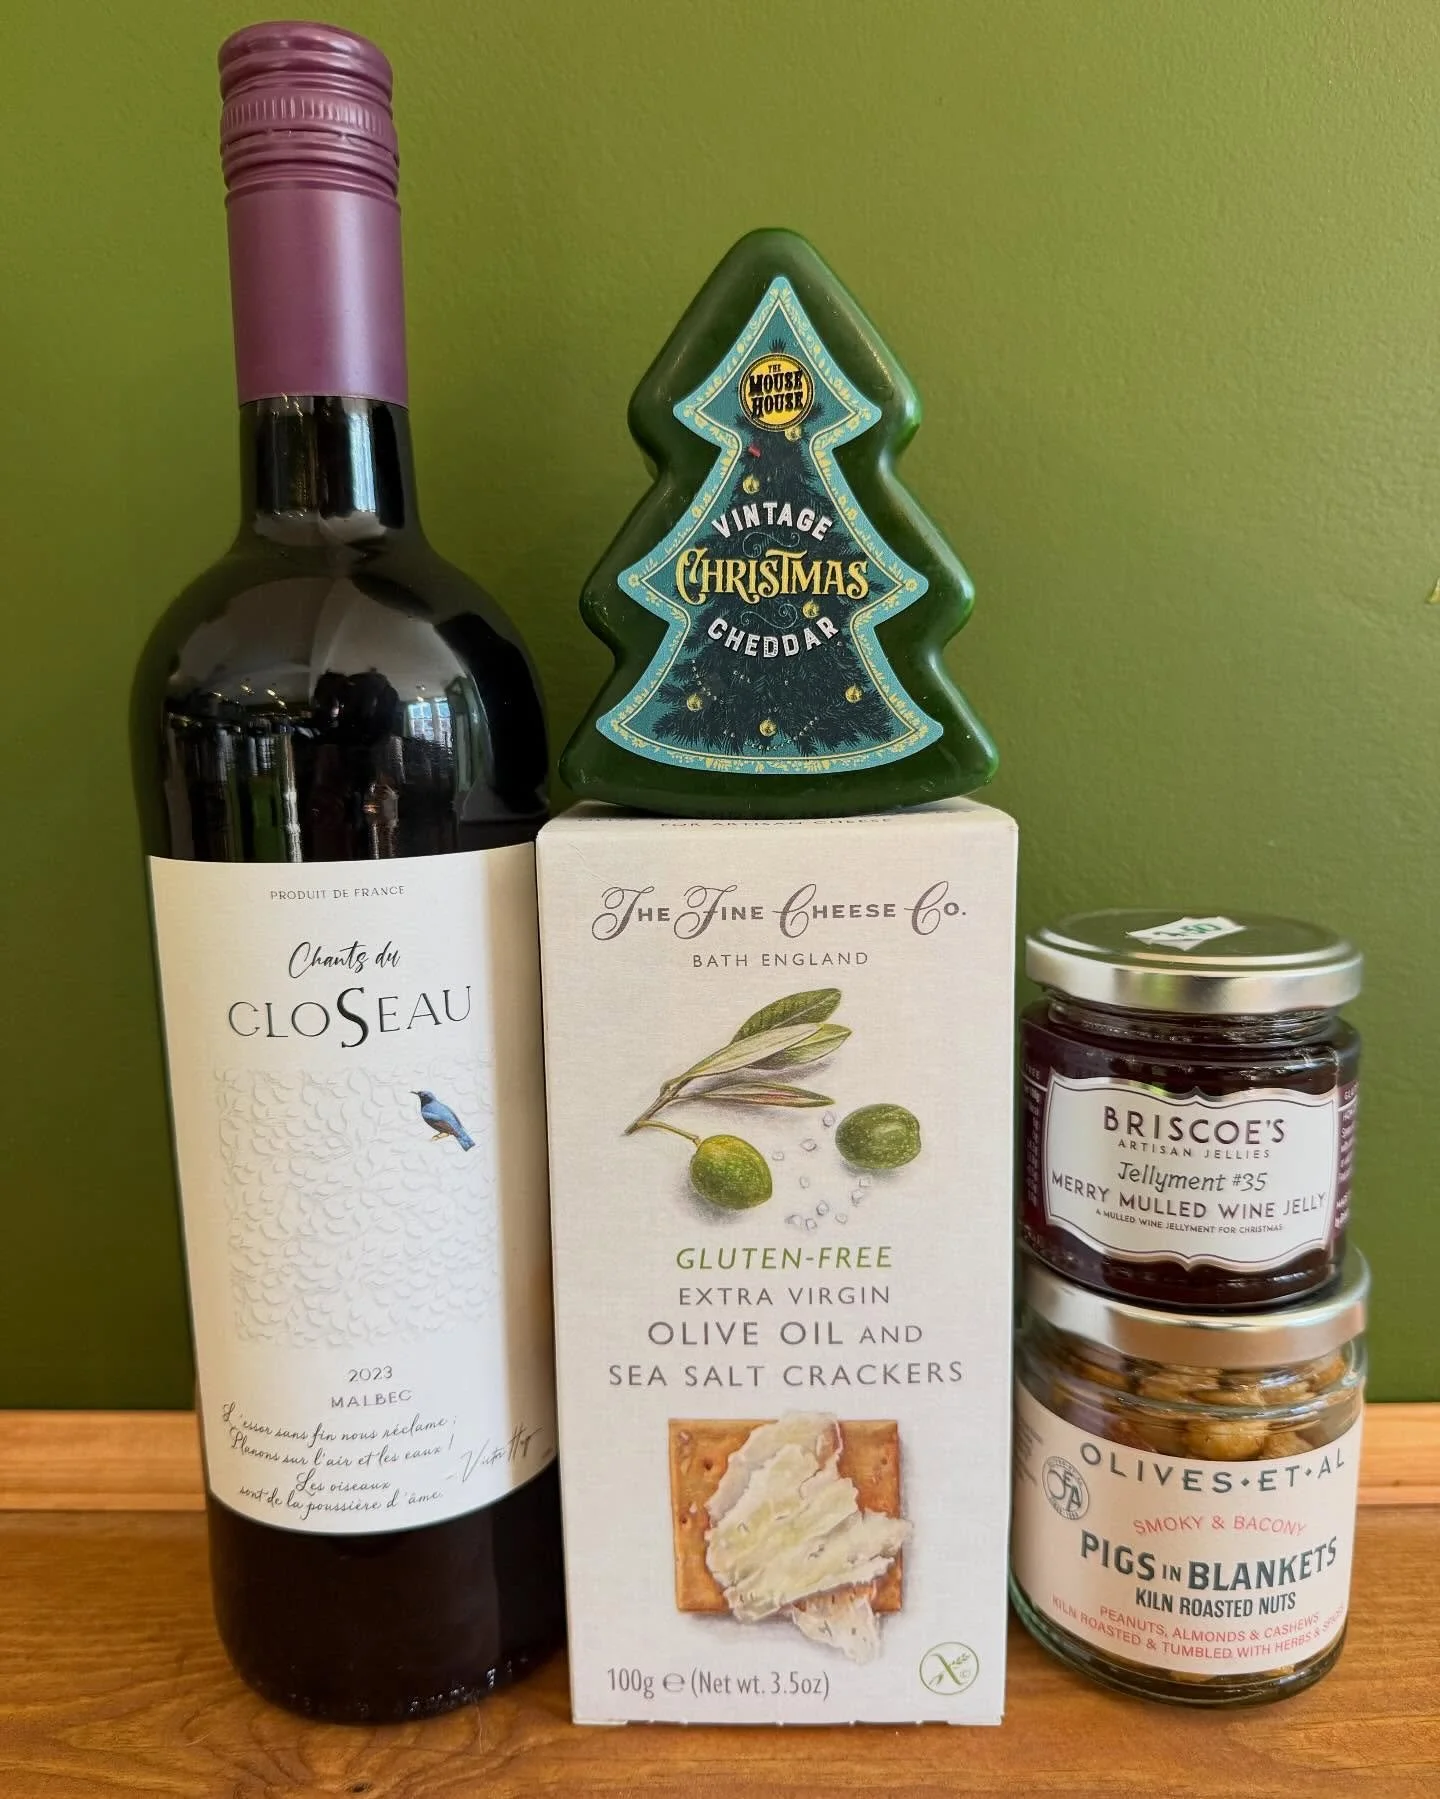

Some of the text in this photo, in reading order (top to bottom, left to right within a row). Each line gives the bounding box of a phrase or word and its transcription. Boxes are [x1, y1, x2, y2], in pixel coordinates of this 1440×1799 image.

[749, 368, 804, 397] MOUSE
[768, 364, 781, 373] THE
[751, 391, 804, 418] HOUSE
[711, 500, 833, 541] VINTAGE
[675, 548, 870, 604] CHRISTMAS
[707, 617, 839, 658] CHEDDAR
[270, 885, 406, 901] PRODUIT DE FRANCE
[288, 940, 400, 979] Chants du
[692, 951, 869, 968] BATH ENGLAND
[1103, 1105, 1287, 1145] BRISCOE'S
[1118, 1138, 1271, 1160] ARTISAN JELLIES
[1117, 1160, 1269, 1193] Jellyment #35
[1051, 1169, 1327, 1219] MERRY MULLED WINE JELLY
[1095, 1208, 1284, 1234] A MULLED WINE JELLYMENT FOR CHRISTMAS
[676, 1246, 893, 1270] GLUTEN-FREE
[679, 1285, 891, 1306] EXTRA VIRGIN
[648, 1321, 923, 1346] OLIVE OIL AND
[348, 1365, 394, 1382] 2023
[609, 1360, 964, 1388] SEA SALT CRACKERS
[331, 1389, 413, 1409] MALBEC
[221, 1401, 273, 1436] L'essor
[274, 1426, 309, 1441] sans
[308, 1422, 336, 1448] fin
[340, 1430, 378, 1442] nous
[229, 1426, 281, 1461] Planons
[281, 1455, 309, 1466] sur
[313, 1447, 352, 1467] l'air
[358, 1451, 377, 1467] et
[376, 1445, 400, 1467] les
[295, 1468, 392, 1497] Les oiseaux
[239, 1485, 268, 1500] sont
[267, 1488, 283, 1508] de
[286, 1490, 304, 1509] la
[300, 1498, 382, 1521] poussière
[1133, 1515, 1307, 1537] SMOKY & BACONY
[1080, 1529, 1338, 1592] PIGS IN BLANKETS
[1135, 1587, 1297, 1618] KILN ROASTED NUTS
[1051, 1594, 1077, 1621] KILN
[1080, 1613, 1142, 1646] ROASTED
[1146, 1638, 1157, 1650] &
[1162, 1640, 1232, 1660] TUMBLED
[1237, 1644, 1271, 1658] WITH
[1274, 1631, 1312, 1652] HERBS
[1100, 1605, 1320, 1643] PEANUTS, ALMONDS & CASHEWS
[607, 1667, 655, 1699] 100g
[690, 1668, 732, 1698] (Net
[736, 1673, 766, 1695] wt.
[770, 1669, 831, 1700] 3.5oz)
